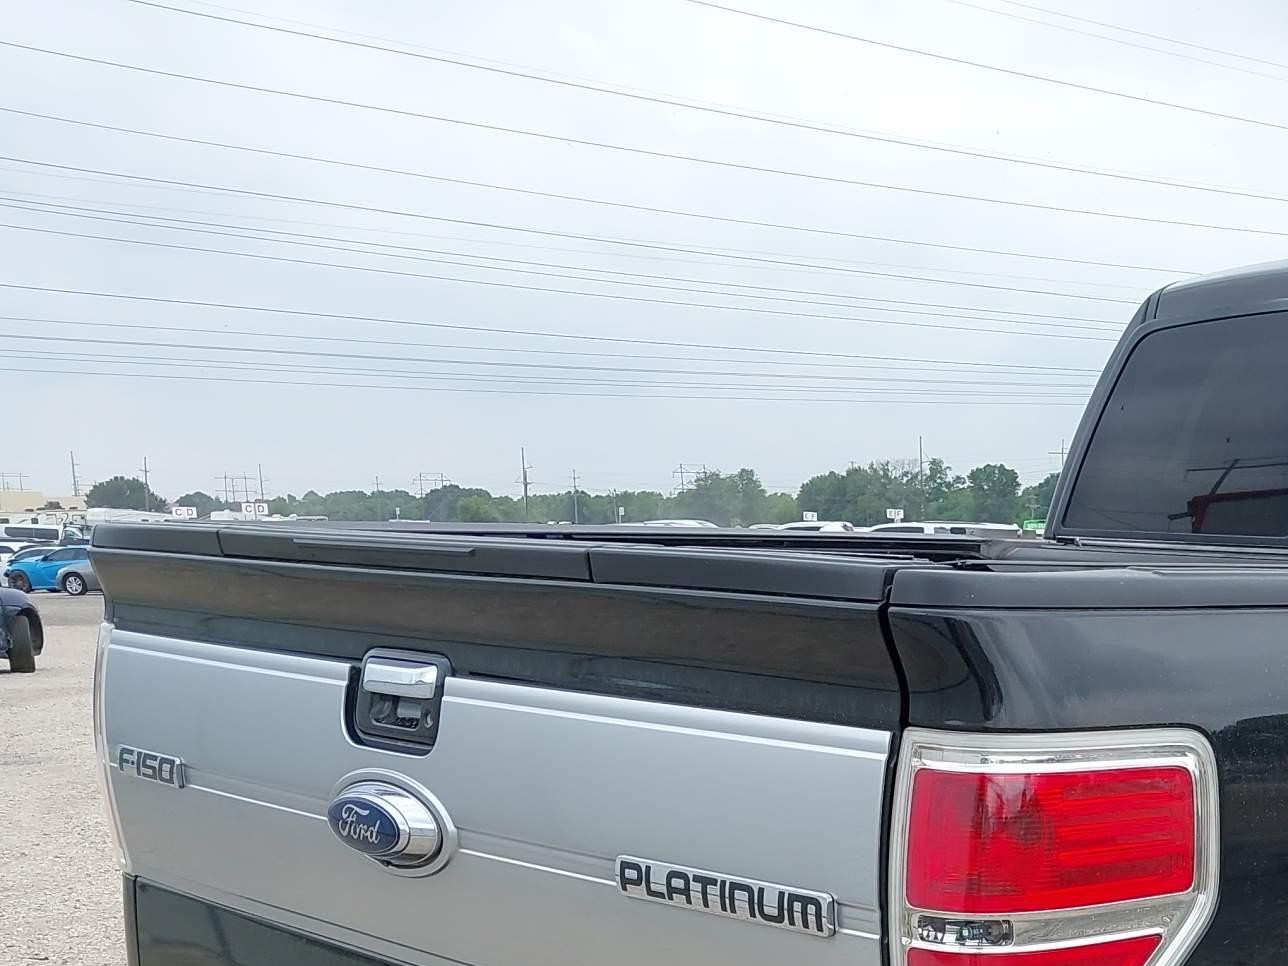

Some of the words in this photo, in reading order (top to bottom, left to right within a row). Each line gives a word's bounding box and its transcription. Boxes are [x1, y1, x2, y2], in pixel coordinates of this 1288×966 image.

[174, 508, 183, 516] C
[186, 508, 194, 516] D
[245, 504, 253, 513] C
[257, 504, 265, 513] D
[119, 747, 176, 785] F-150
[338, 803, 381, 844] Ford
[619, 860, 824, 933] PLATINUM
